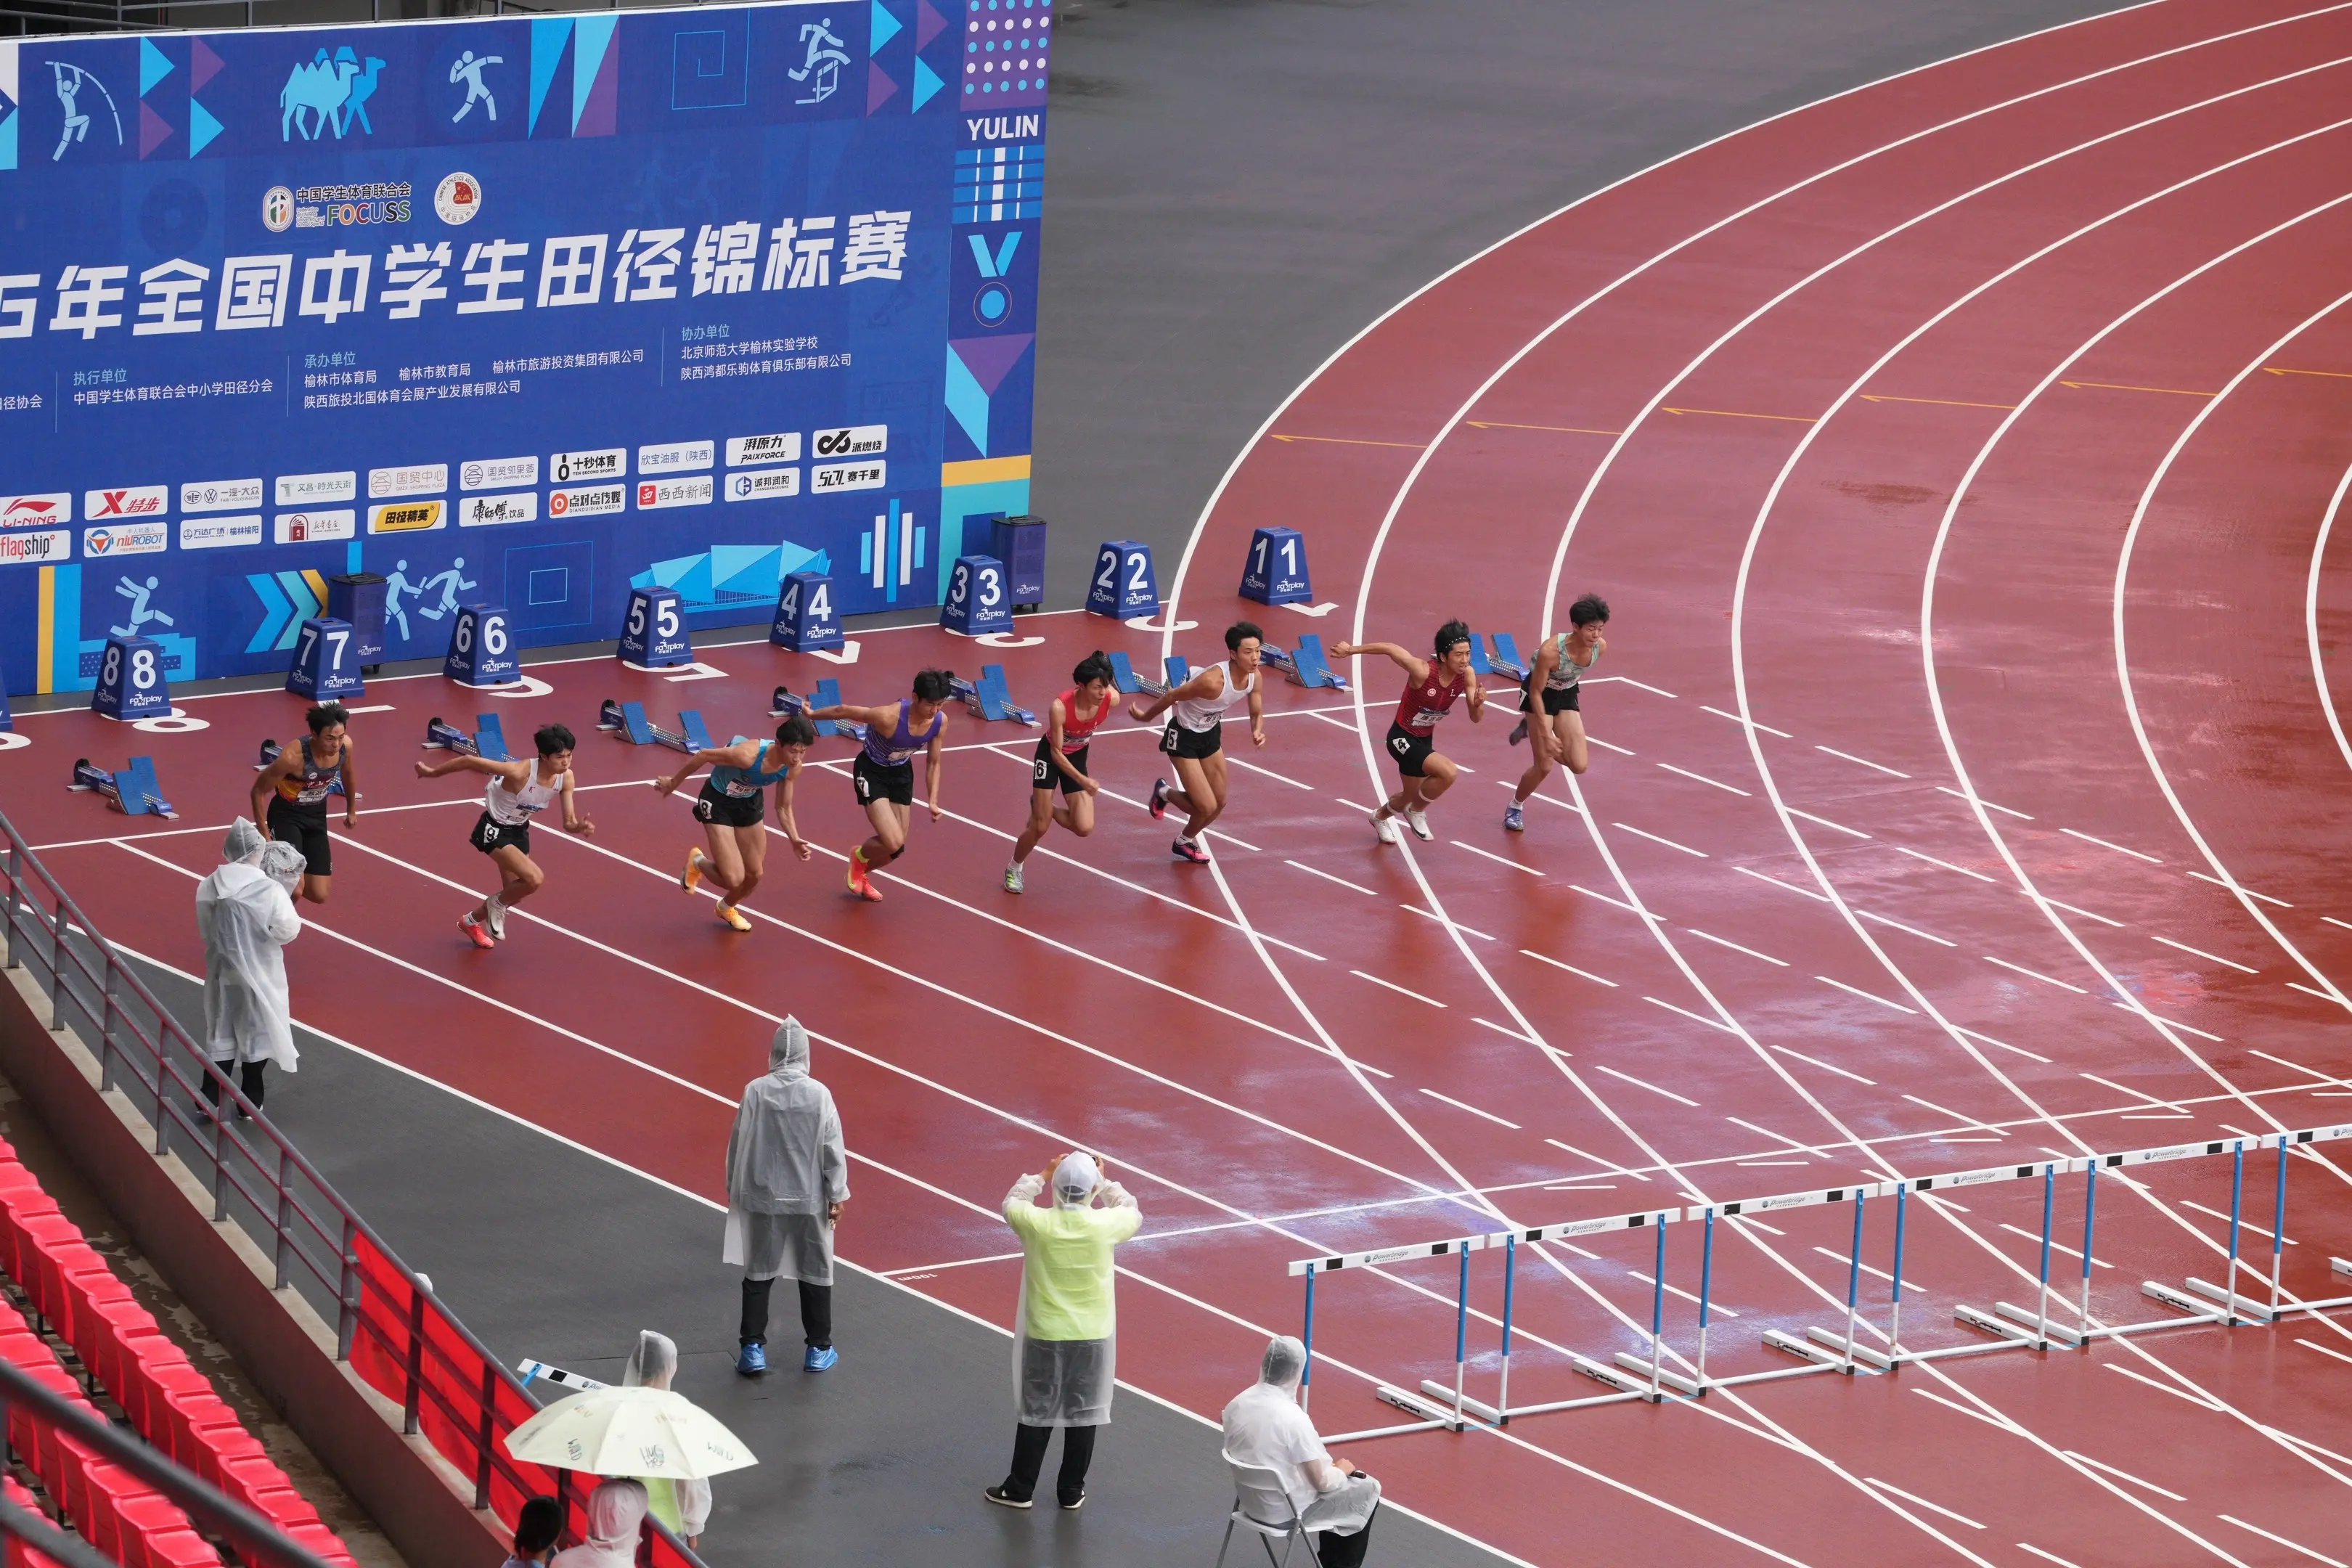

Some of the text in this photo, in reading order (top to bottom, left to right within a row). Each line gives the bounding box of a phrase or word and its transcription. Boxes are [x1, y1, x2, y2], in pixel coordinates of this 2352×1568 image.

[967, 115, 1039, 141] YULIN
[296, 182, 411, 203] 中国学生体育联合会
[446, 176, 465, 186] ATHLETICS
[465, 177, 478, 199] ASSOCIATION
[327, 200, 411, 226] FOCUSS
[682, 324, 730, 341] 协办单位
[681, 336, 818, 360] 北京师范大学榆林实验学校
[304, 351, 356, 369] 承办单位
[304, 348, 644, 388] 榆林市体育局 榆林市教育局 榆林市旅游投资集团有限公司
[681, 354, 852, 381] 陕西鸿都乐驹体育俱乐部有限公司
[73, 368, 127, 386] 执行单位
[0, 393, 43, 411] 径协会
[73, 378, 273, 406] 中国学生体育联合会中小学田径分会
[304, 380, 520, 409] 陕西旅投北国体育会展产业发展有限公司
[743, 435, 783, 451] 湃原力
[852, 440, 882, 452] 派燃烧
[573, 454, 616, 470] 十秒体育
[740, 451, 786, 465] PAIXFORCE
[397, 470, 445, 484] 国贸中心
[754, 475, 790, 487] 诚邦润和
[847, 469, 880, 482] 赛千里
[569, 491, 621, 507] 点对点传媒
[658, 483, 711, 501] 西西新闻
[124, 497, 160, 513] 特步
[385, 508, 430, 524] 田径精英
[509, 509, 525, 518] 饮品
[3, 515, 57, 528] LI-NING
[193, 526, 259, 536] 万达广场 榆林榆阳
[0, 534, 50, 560] flagship
[1255, 538, 1268, 574] 1
[1281, 539, 1297, 576] 1
[1097, 550, 1117, 589] 2
[1127, 552, 1148, 590] 2
[952, 565, 968, 603] 3
[979, 568, 1001, 606] 3
[781, 583, 799, 621] 4
[808, 584, 832, 621] 4
[629, 597, 647, 635] 5
[657, 599, 679, 637] 5
[456, 614, 473, 653] 6
[484, 616, 507, 655] 6
[300, 627, 318, 666] 7
[327, 631, 349, 670] 7
[104, 647, 120, 686] 8
[132, 649, 156, 689] 8
[1168, 730, 1176, 747] 5
[1397, 739, 1407, 750] 4
[1037, 761, 1045, 777] 6
[701, 802, 709, 817] 8
[486, 827, 496, 842] 9
